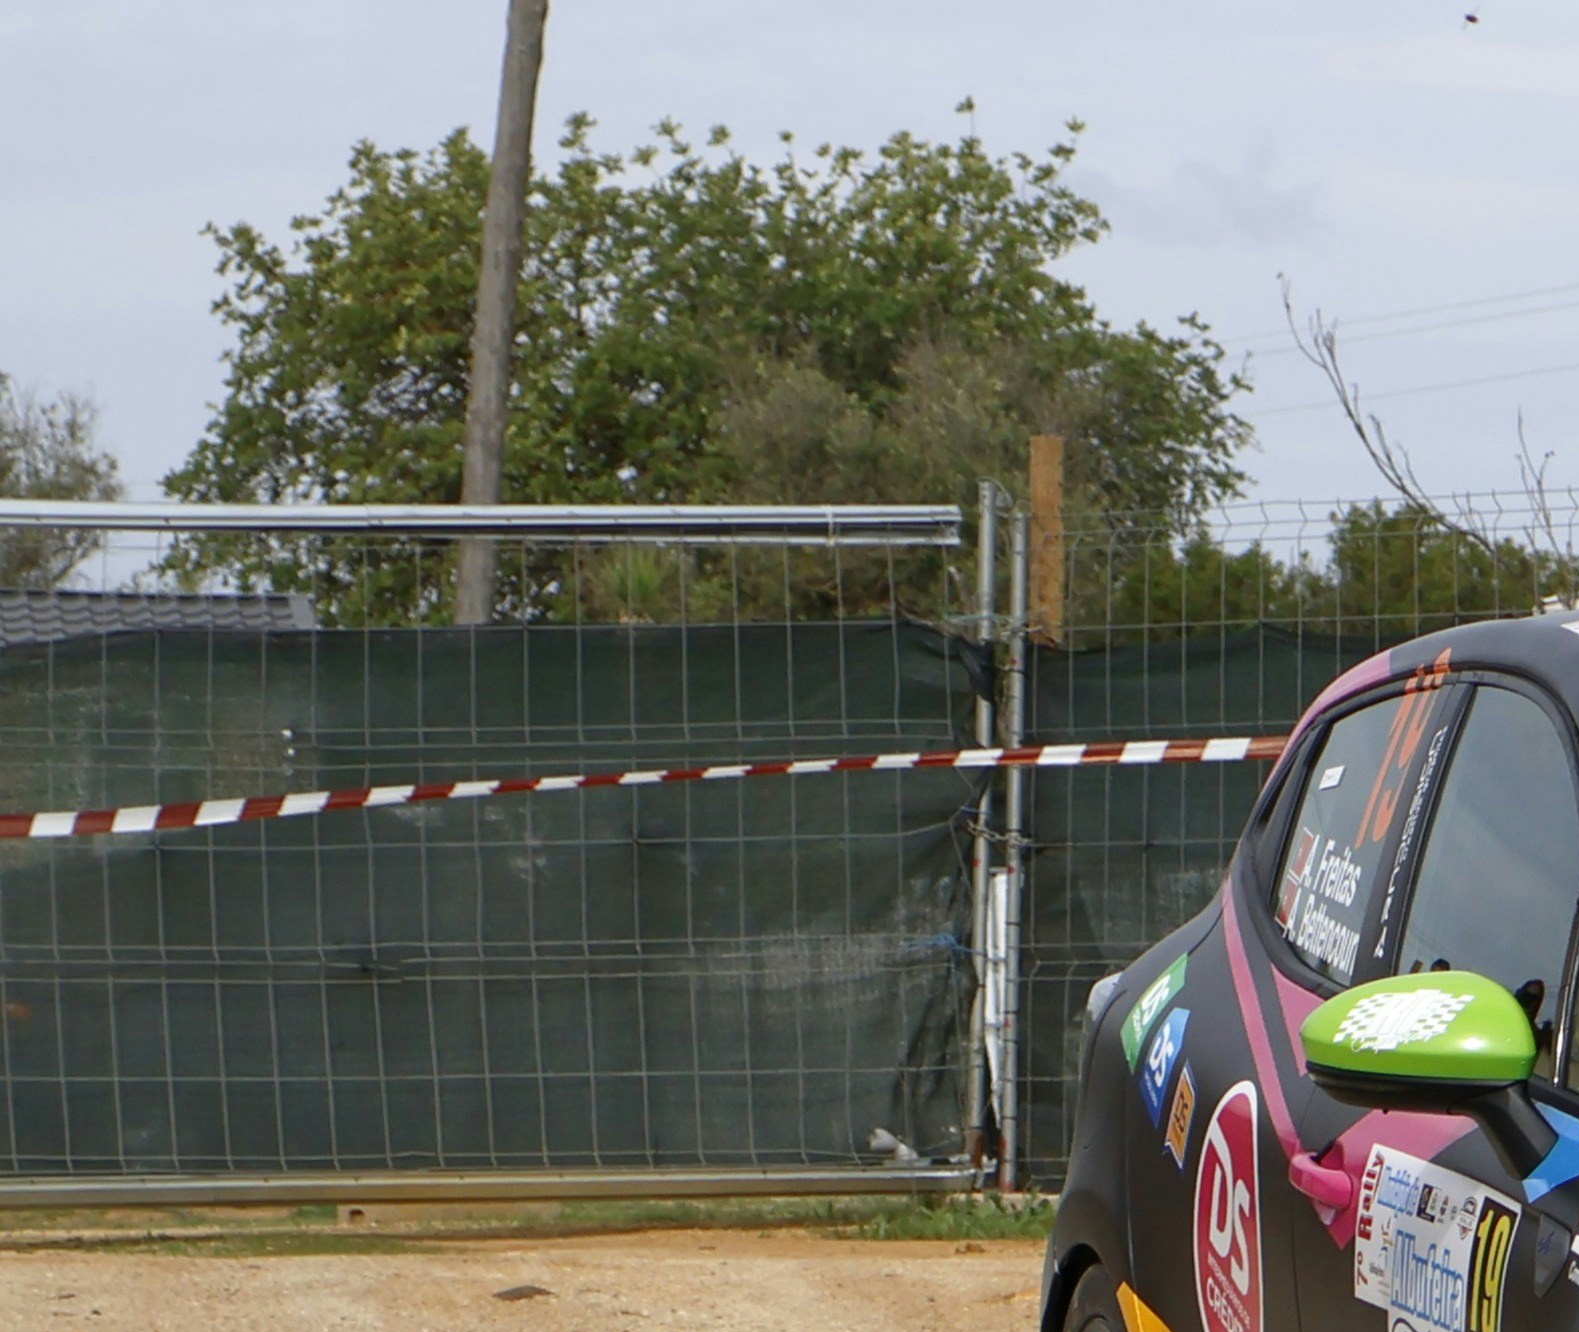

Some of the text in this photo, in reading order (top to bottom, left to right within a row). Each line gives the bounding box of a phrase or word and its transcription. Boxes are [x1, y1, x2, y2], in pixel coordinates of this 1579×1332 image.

[1299, 834, 1361, 908] A. Freitas
[1283, 887, 1301, 943] A.
[1208, 1120, 1251, 1297] DS
[1358, 1150, 1385, 1241] Rally
